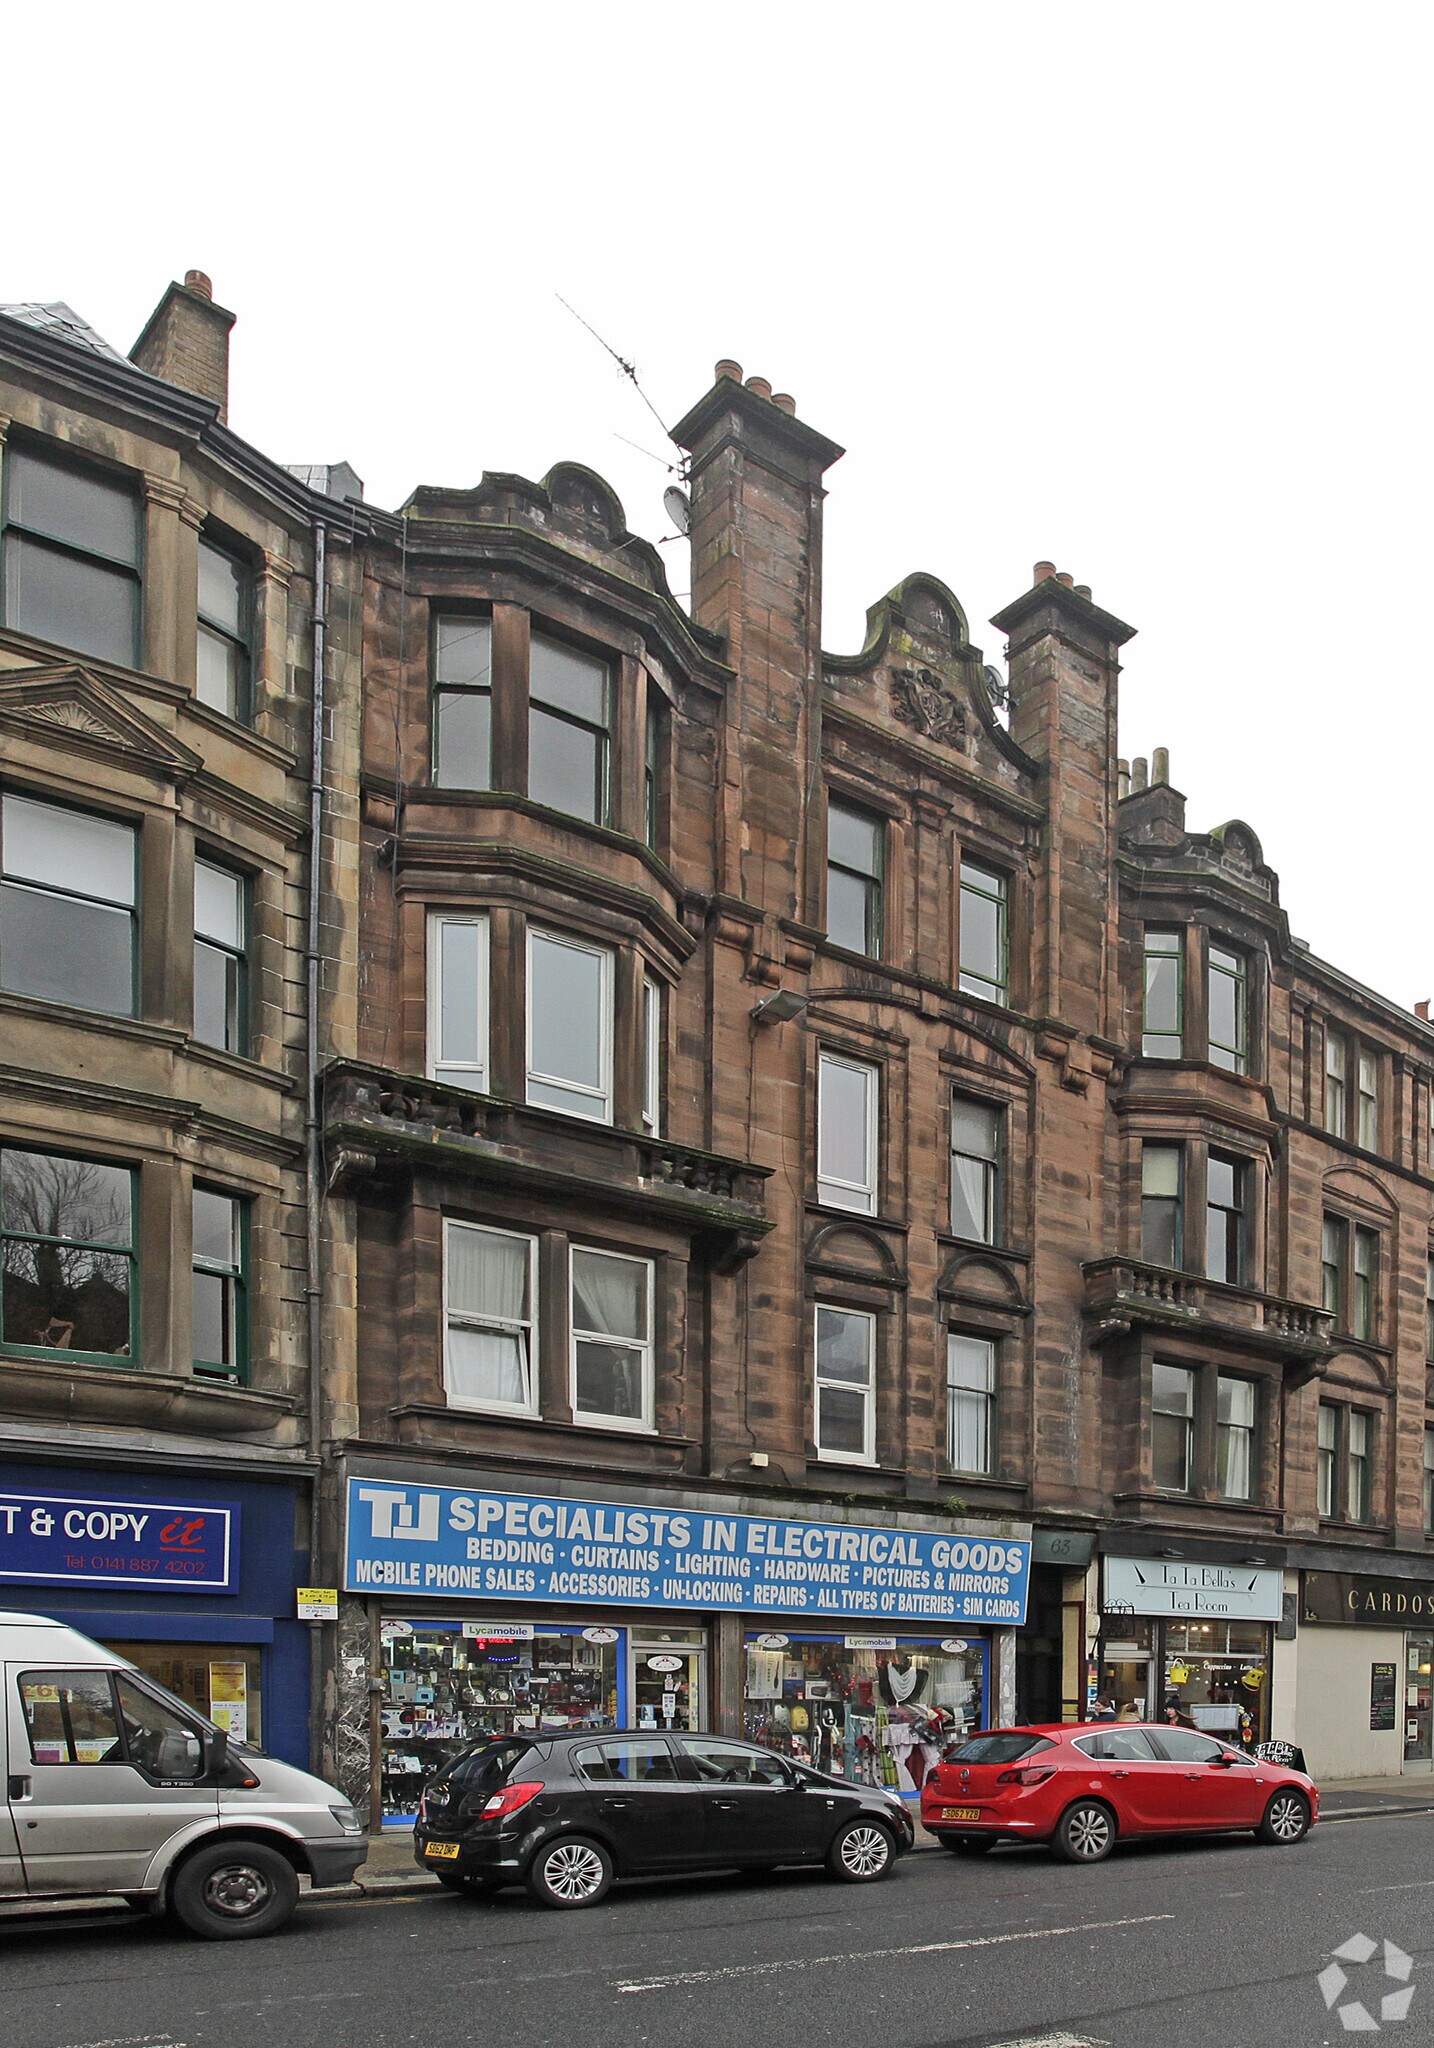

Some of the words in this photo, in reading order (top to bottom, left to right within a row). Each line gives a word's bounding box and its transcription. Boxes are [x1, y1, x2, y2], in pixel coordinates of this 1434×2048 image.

[30, 1508, 55, 1536] &
[64, 1510, 149, 1542] COPY
[160, 1517, 206, 1545] it
[448, 1497, 691, 1549] SPECIALISTS
[702, 1519, 737, 1552] IN
[747, 1523, 923, 1567] ELECTRICAL
[931, 1540, 1023, 1575] GOODS
[1051, 1539, 1071, 1556] 63
[91, 1556, 125, 1570] 0141
[130, 1559, 160, 1572] 887
[164, 1561, 206, 1575] 4202
[467, 1537, 554, 1565] BEDDING
[571, 1545, 660, 1572] CURTAINS
[675, 1553, 751, 1578] LIGHTING
[764, 1559, 851, 1584] HARDWARE
[863, 1566, 930, 1589] PICTURES
[933, 1571, 945, 1590] &
[949, 1573, 1009, 1594] MIRRORS
[1161, 1565, 1177, 1584] Ta
[1181, 1567, 1197, 1586] Ta
[1201, 1568, 1236, 1588] Bella's
[356, 1559, 421, 1586] MOBILE
[425, 1563, 481, 1589] PHONE
[485, 1567, 536, 1592] SALES
[548, 1571, 650, 1598] ACCESSORIES
[662, 1578, 743, 1603] UN-LOCKING
[754, 1583, 808, 1607] REPAIRS
[817, 1588, 839, 1608] ALL
[841, 1590, 878, 1611] TYPES
[881, 1592, 896, 1611] OF
[898, 1593, 955, 1615] BATTERIES
[963, 1597, 983, 1616] SIM
[985, 1599, 1020, 1618] CARDS
[1169, 1590, 1190, 1610] Tea
[1195, 1592, 1228, 1612] Room
[469, 1625, 528, 1636] Lycamobile
[849, 1638, 892, 1648] Lycamobile
[1203, 1663, 1232, 1671] Cappuccino
